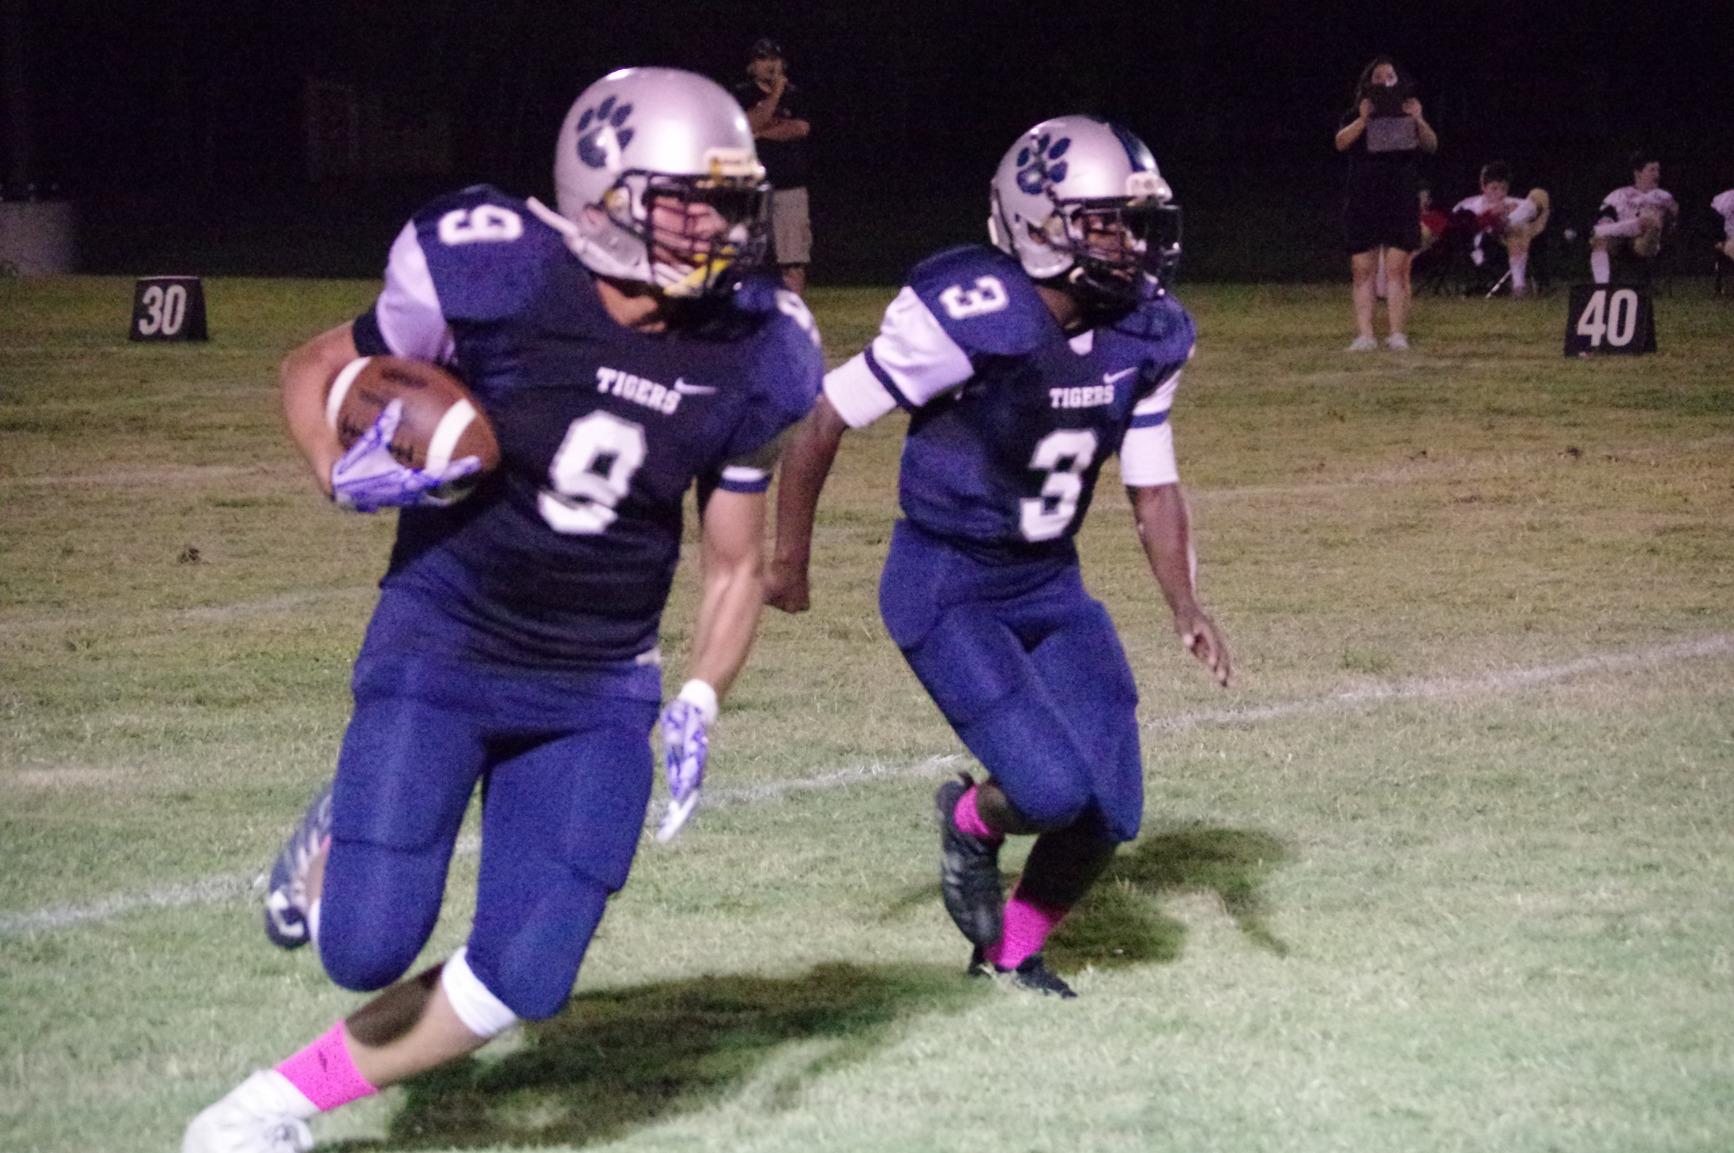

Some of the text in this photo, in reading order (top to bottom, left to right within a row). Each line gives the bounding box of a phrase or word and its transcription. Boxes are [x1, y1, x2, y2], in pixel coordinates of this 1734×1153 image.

[438, 204, 522, 245] 9
[138, 285, 187, 335] 30
[939, 276, 1008, 319] 3
[1577, 289, 1638, 347] 40
[596, 366, 681, 414] TIGERS
[1049, 384, 1114, 408] TIGERS
[539, 411, 647, 535] 9
[1020, 429, 1098, 542] 3
